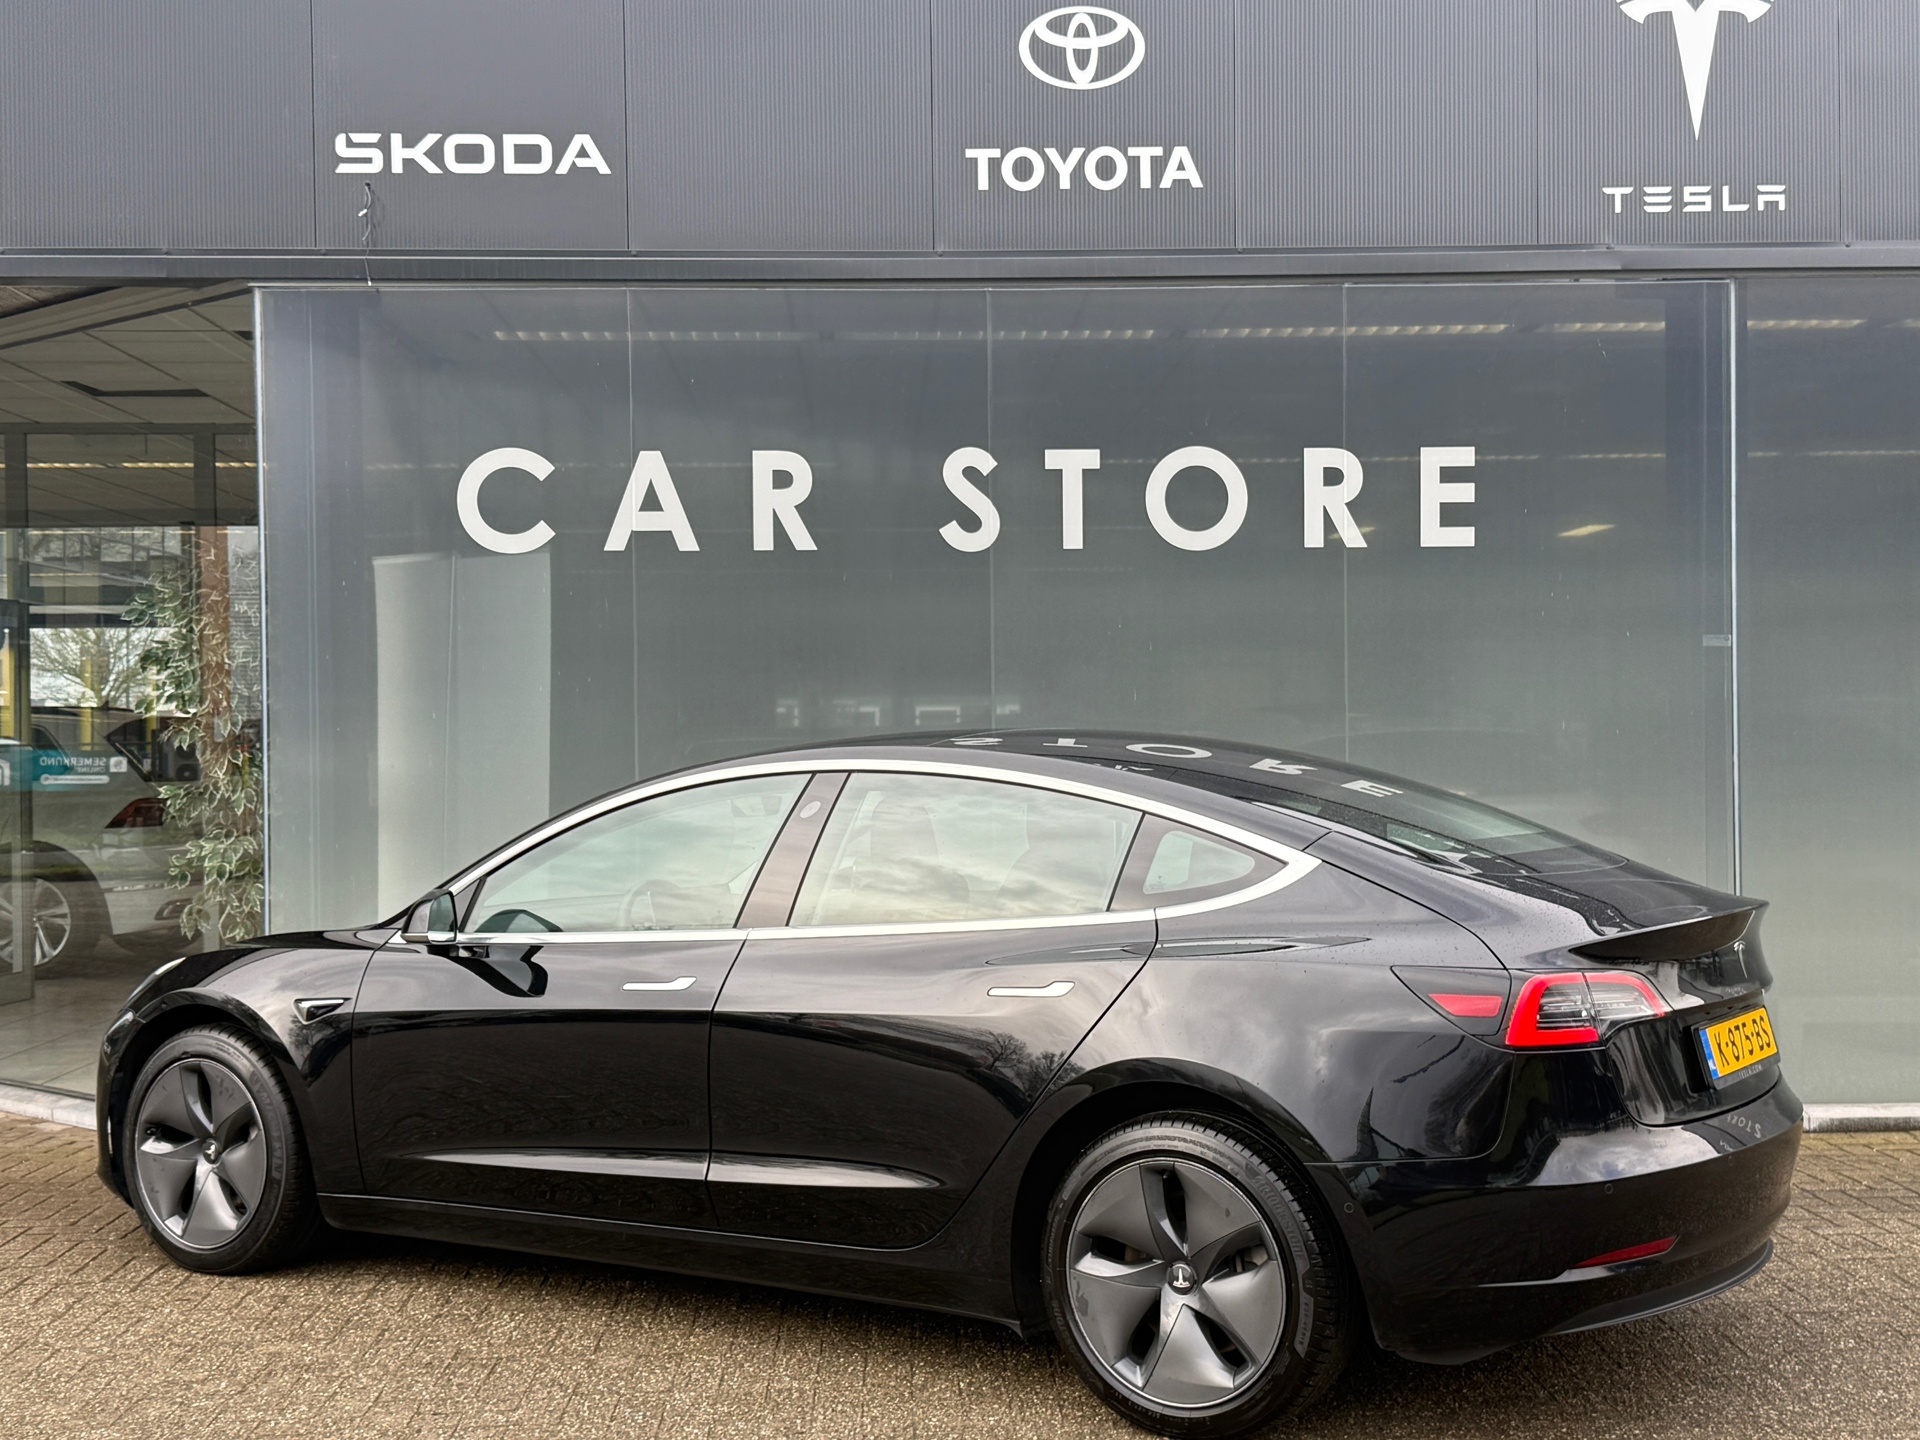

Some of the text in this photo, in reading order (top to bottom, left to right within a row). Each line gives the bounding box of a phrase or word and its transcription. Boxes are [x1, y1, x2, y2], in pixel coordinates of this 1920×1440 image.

[335, 133, 611, 174] SKODA
[966, 146, 1203, 191] TOYOTA
[1602, 185, 1786, 213] TESLA
[456, 446, 1477, 553] CAR STORE
[1714, 1015, 1771, 1067] K-875-BS
